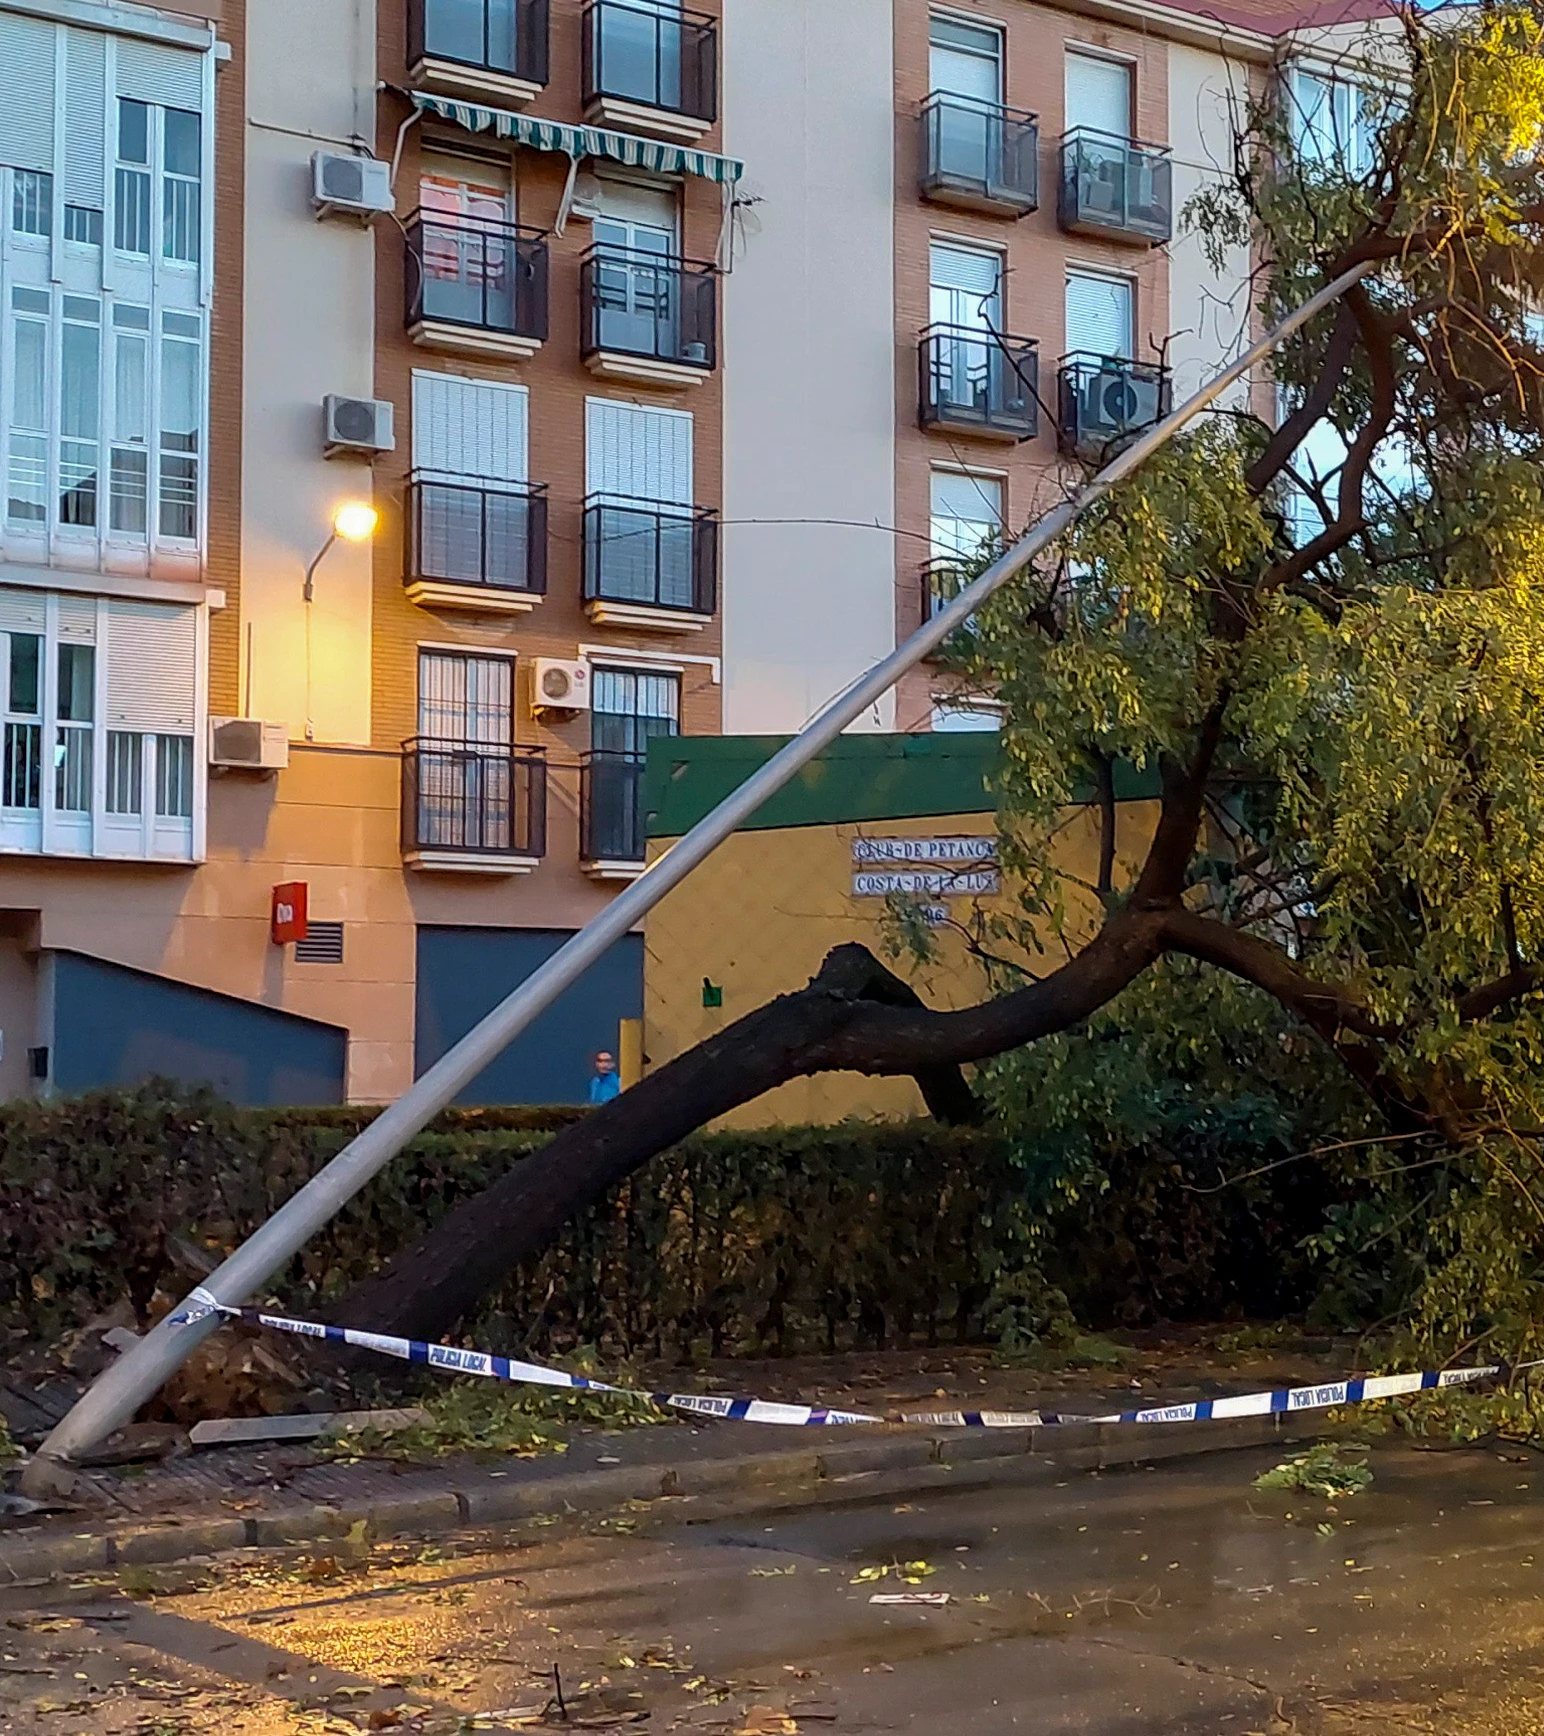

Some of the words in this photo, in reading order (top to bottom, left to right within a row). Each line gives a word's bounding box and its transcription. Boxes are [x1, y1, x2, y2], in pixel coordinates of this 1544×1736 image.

[462, 1353, 487, 1372] LOCAL
[1291, 1390, 1314, 1407] LOCAL
[1315, 1386, 1344, 1404] POLICIA
[1164, 1406, 1192, 1419] POLICIA
